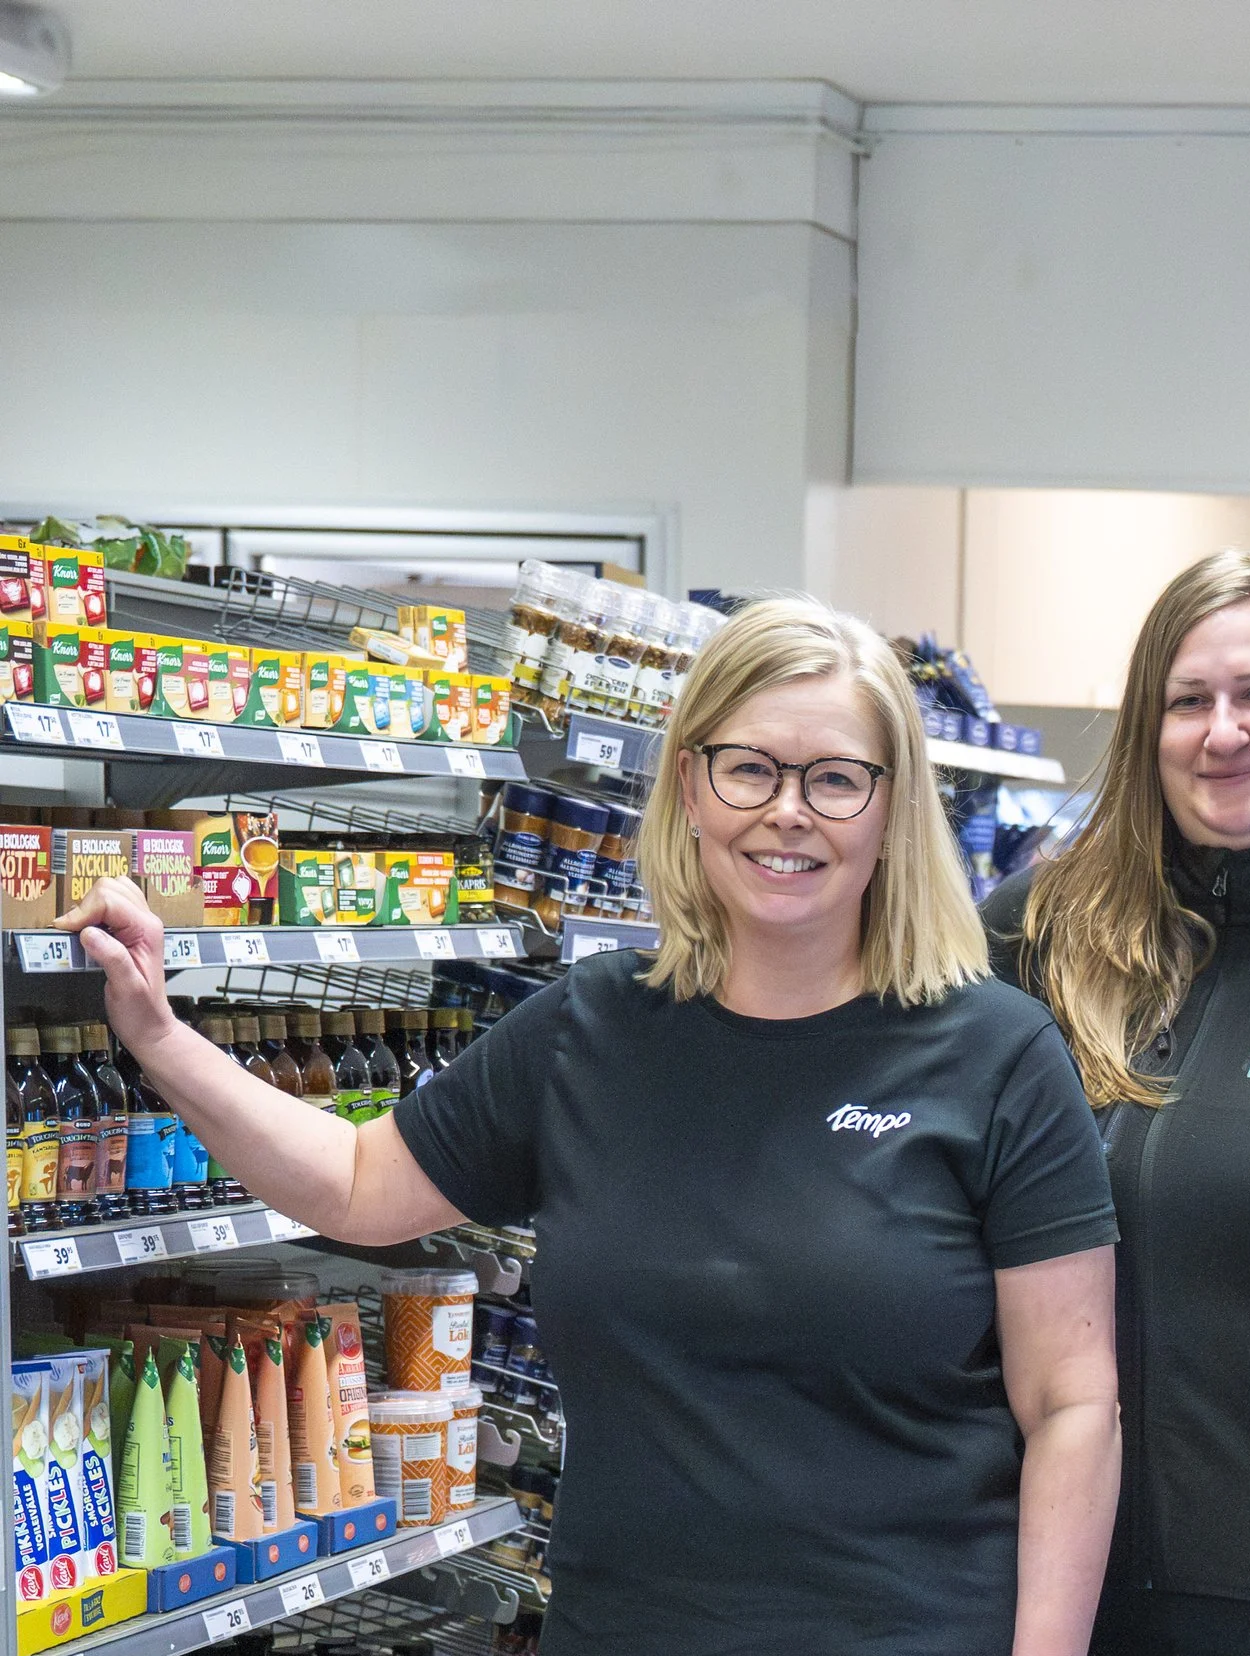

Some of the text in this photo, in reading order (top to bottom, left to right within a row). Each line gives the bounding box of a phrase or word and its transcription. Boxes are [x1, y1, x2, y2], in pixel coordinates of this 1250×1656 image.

[53, 565, 78, 580] Knorr
[52, 641, 78, 657] Knorr
[109, 648, 134, 663] Knorr
[157, 652, 182, 667] Knorr
[209, 659, 228, 674] Knorr
[257, 666, 279, 680] Knorr
[311, 669, 328, 681] Knorr
[4, 834, 41, 849] EKOLOGISK
[82, 839, 121, 854] EKOLOGISK
[150, 839, 185, 853] EKOLOGISK
[202, 841, 230, 856] Knorr
[72, 854, 128, 877] KYCKLING
[143, 855, 192, 876] GRÖNSAKS
[202, 880, 218, 894] BEEF
[457, 878, 487, 891] KAPRIS
[54, 1248, 68, 1265] 39
[85, 1455, 115, 1537] PICKLES
[50, 1465, 78, 1550] PICKLES
[53, 1559, 73, 1589] Kavli
[23, 1571, 41, 1600] Kavli
